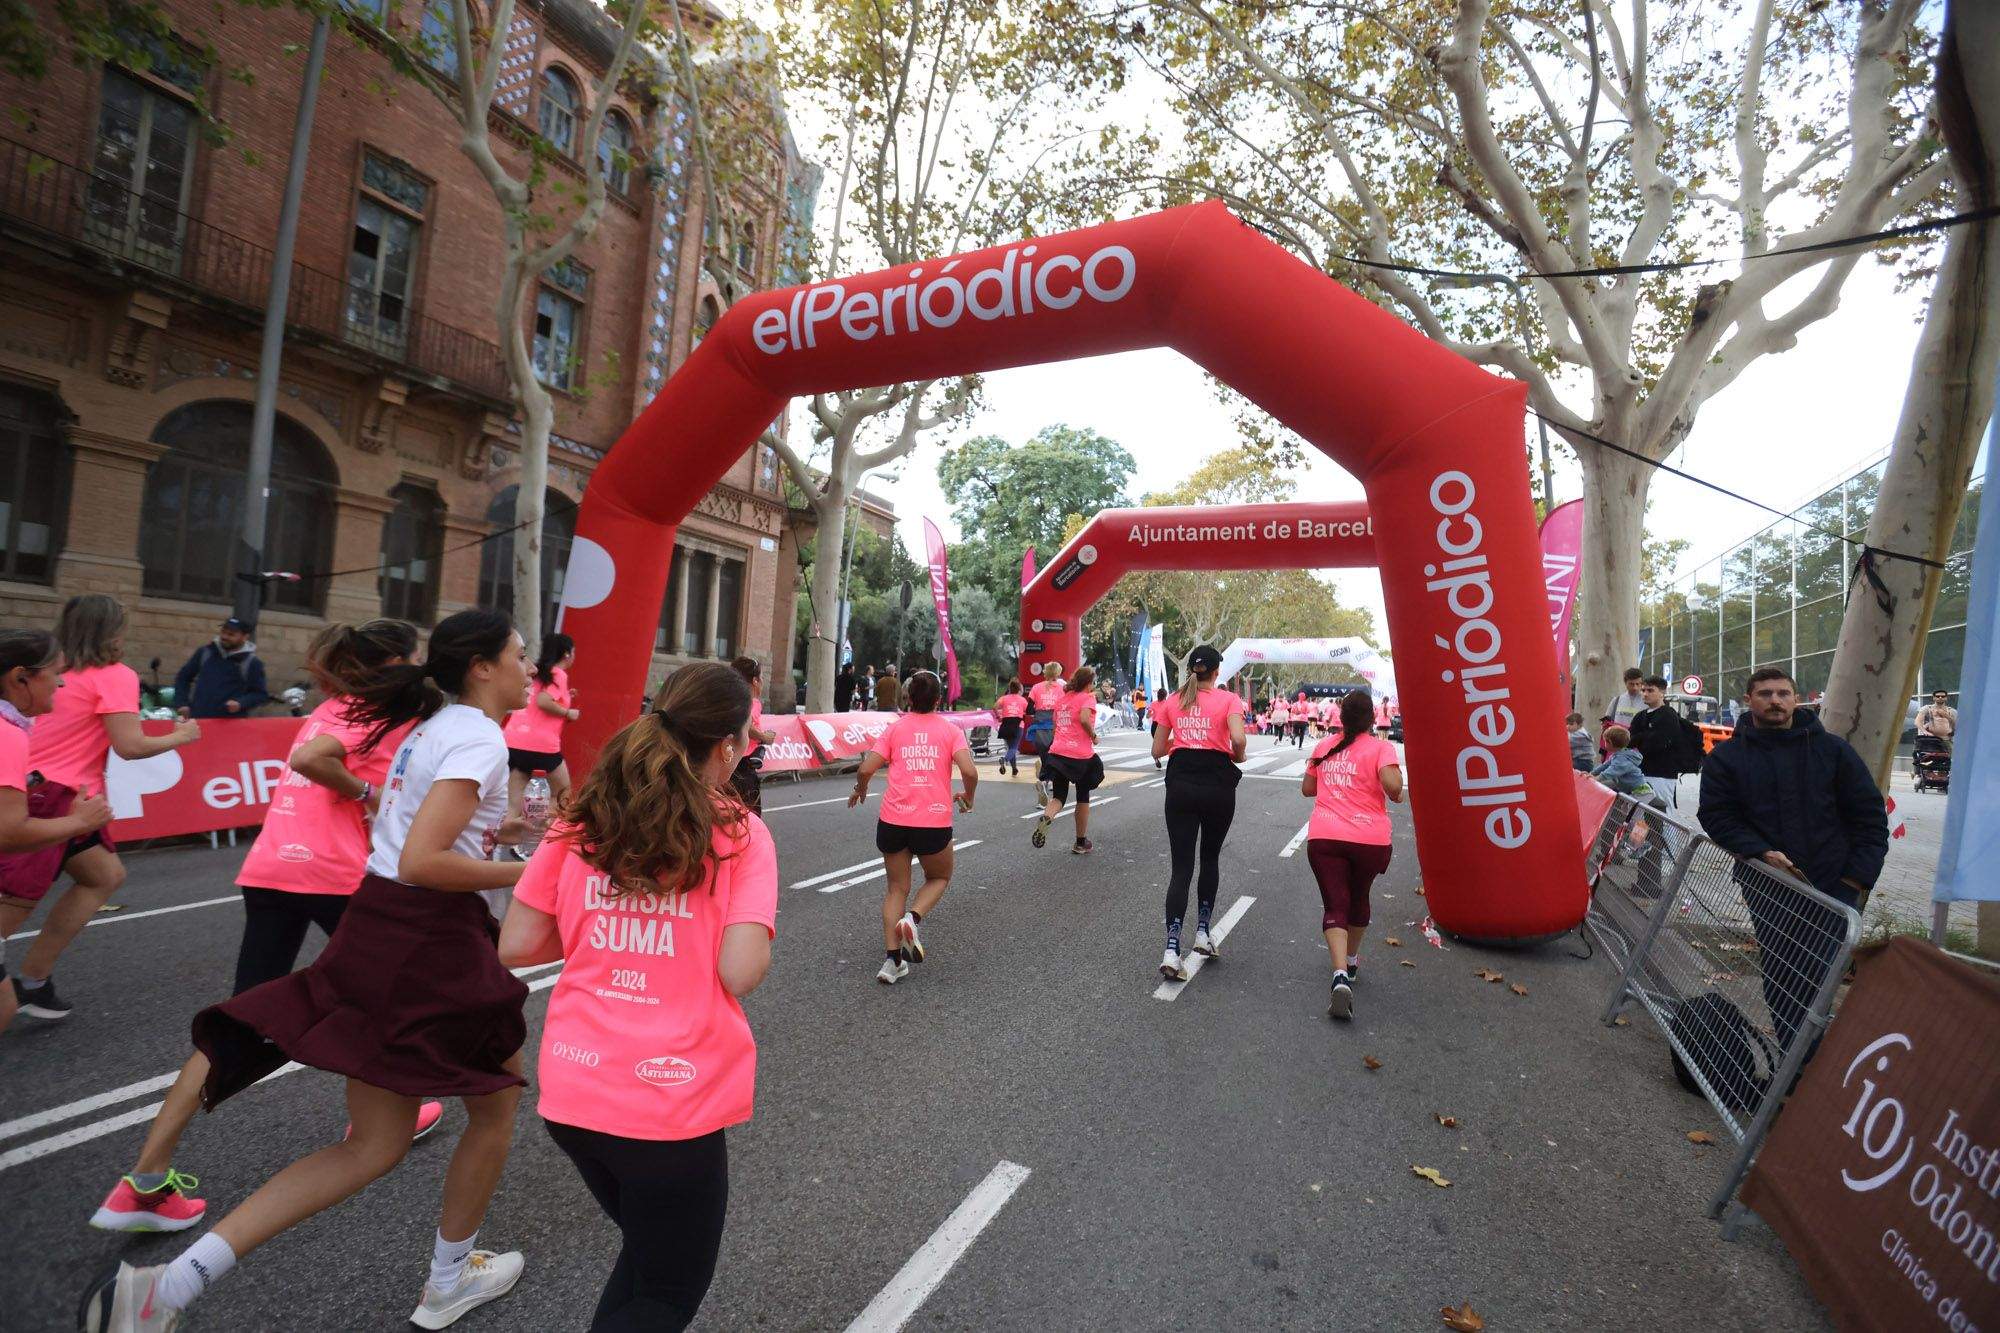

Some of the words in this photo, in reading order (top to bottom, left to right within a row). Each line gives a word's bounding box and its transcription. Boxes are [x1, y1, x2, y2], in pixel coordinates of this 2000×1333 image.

[752, 244, 1136, 355] elPeriódico
[1128, 523, 1256, 547] Ajuntament
[1263, 520, 1291, 540] de
[1298, 516, 1374, 538] Barcel
[1424, 470, 1532, 849] elPeriódico
[1686, 682, 1697, 690] 30
[1177, 716, 1212, 729] DORSAL
[913, 732, 928, 744] TU
[1181, 729, 1208, 741] SUMA
[901, 745, 940, 759] DORSAL
[906, 758, 935, 771] SUMA
[1322, 760, 1359, 775] DORSAL
[1325, 772, 1352, 787] SUMA
[590, 914, 675, 958] SUMA
[611, 968, 647, 992] 2024
[552, 1041, 600, 1068] OYSHO
[1880, 1227, 1938, 1302] Clínica
